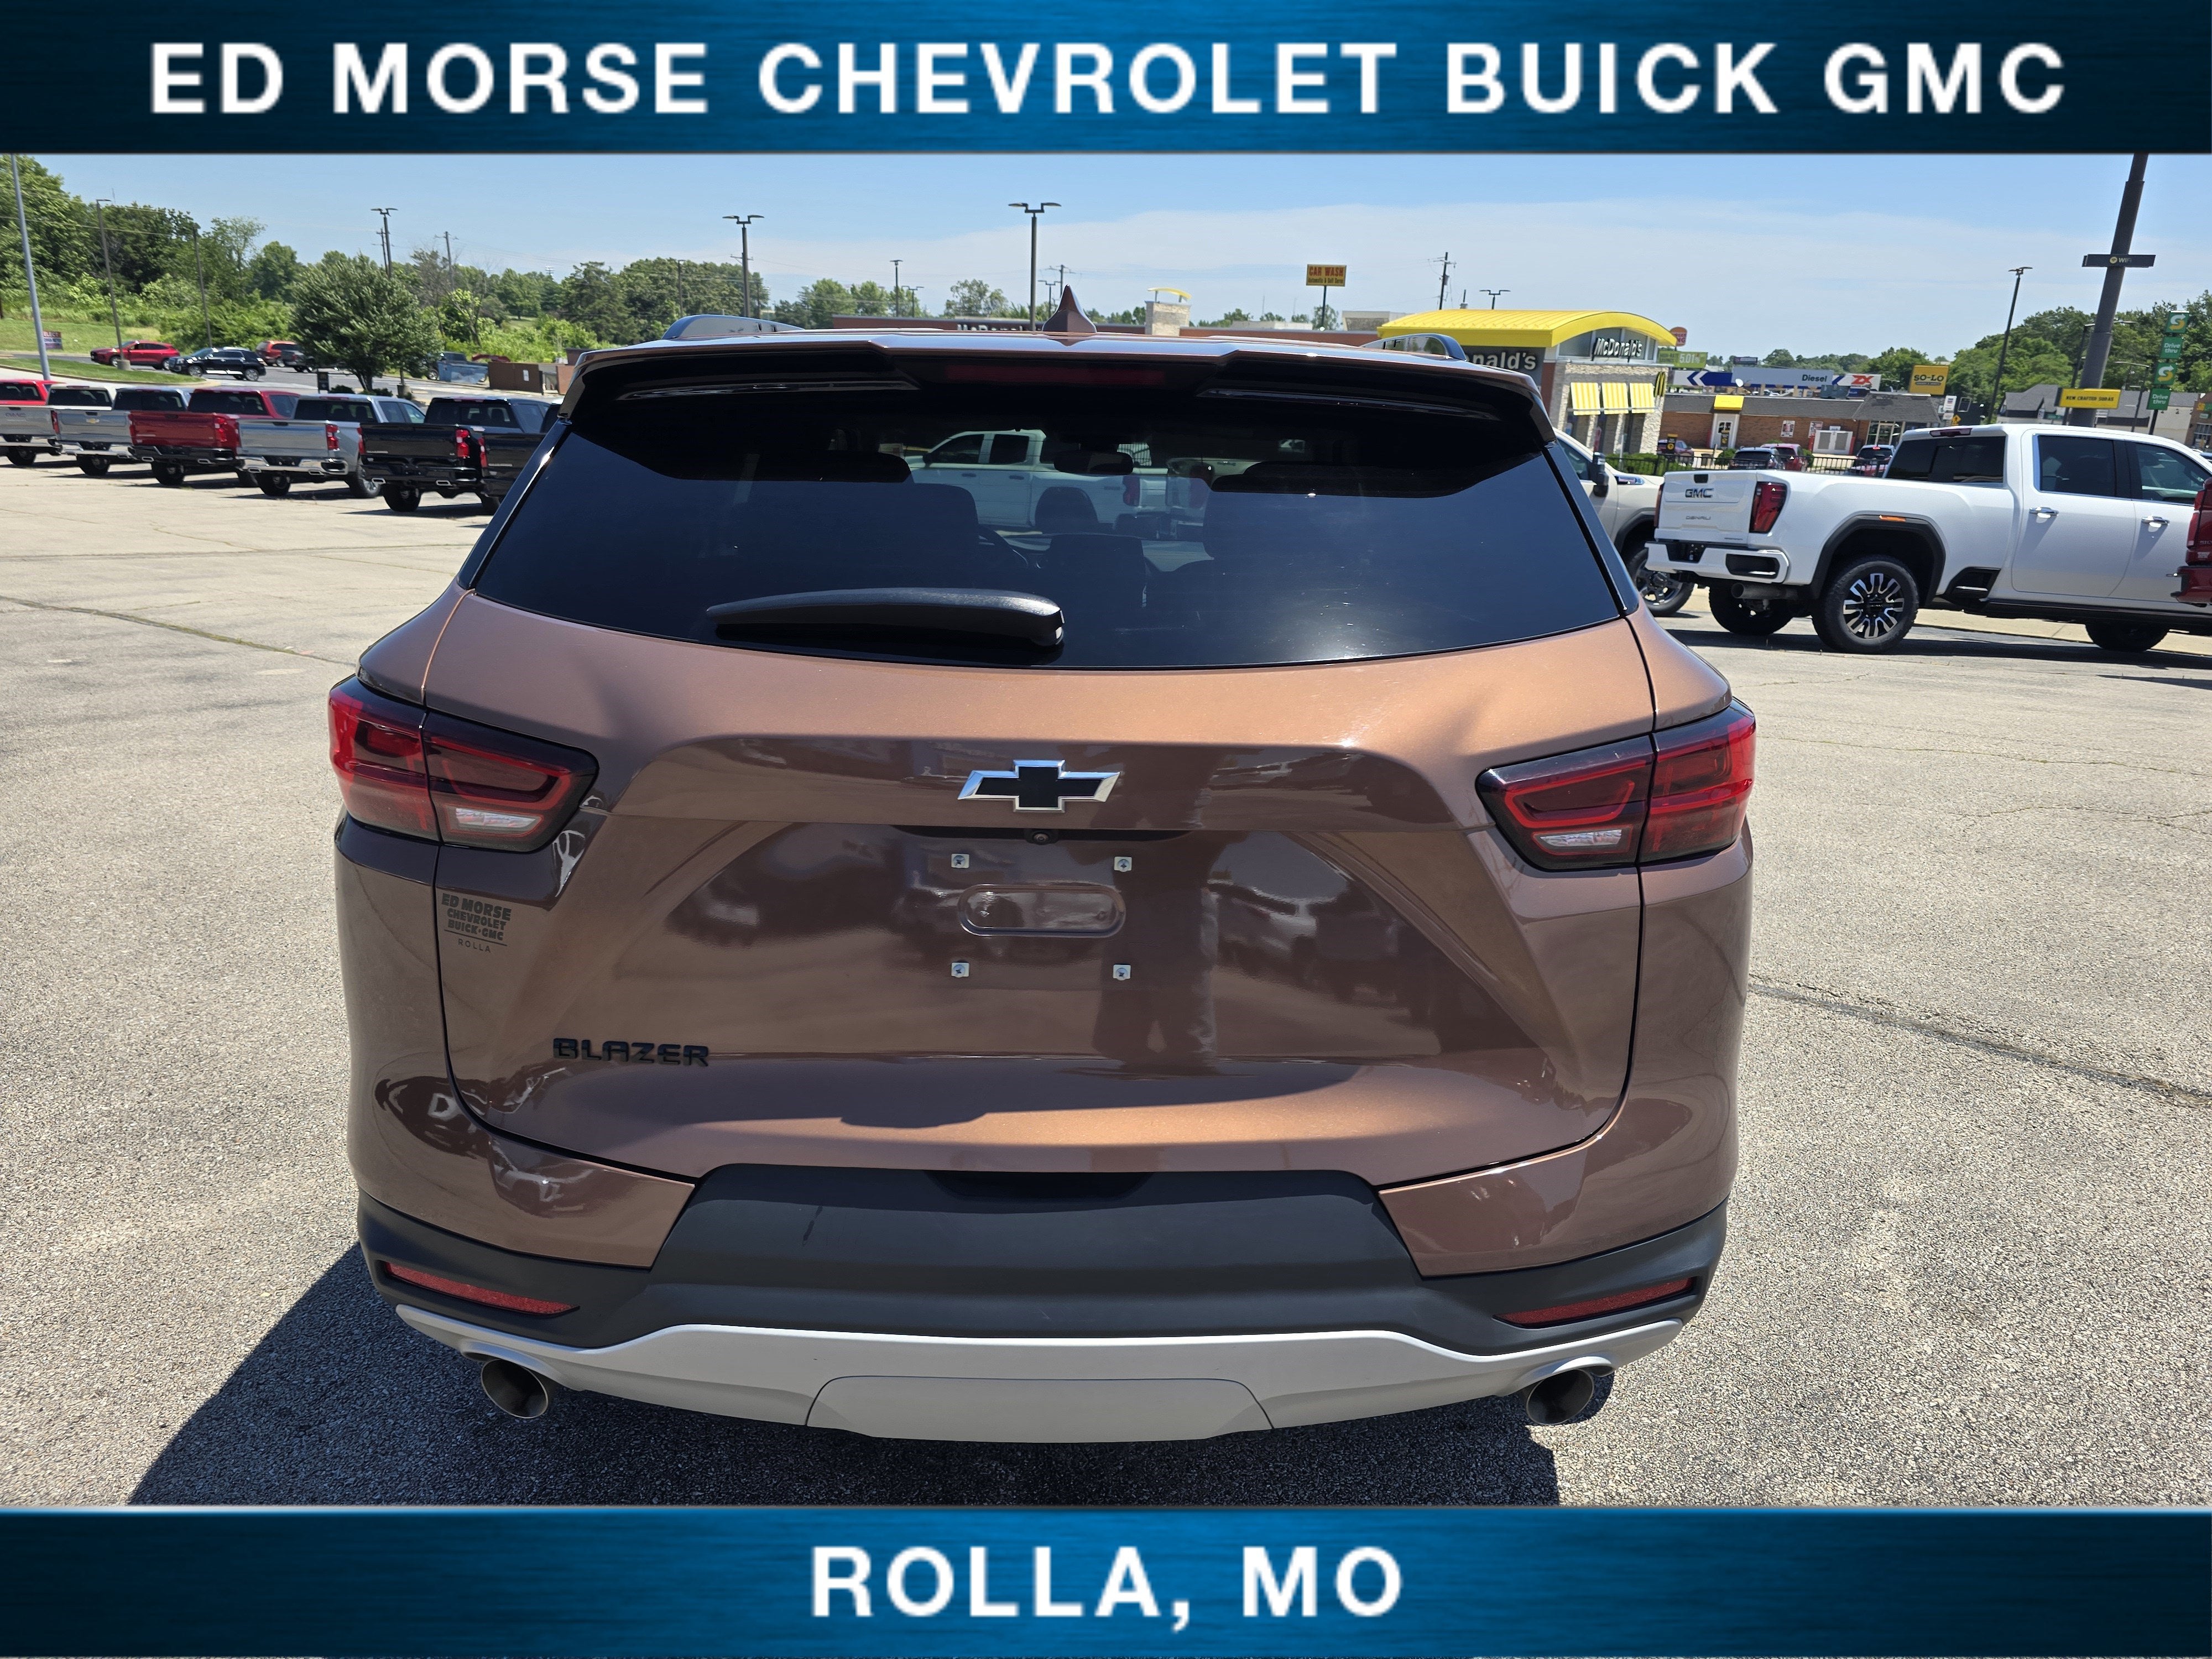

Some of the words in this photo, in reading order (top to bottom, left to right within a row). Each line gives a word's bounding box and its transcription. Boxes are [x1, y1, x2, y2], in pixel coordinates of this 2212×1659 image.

[1309, 266, 1322, 276] CAR
[1324, 267, 1344, 276] WASH
[1594, 338, 1642, 356] McDonald's
[1851, 375, 1874, 385] ZX
[1685, 488, 1714, 498] GMC
[441, 893, 460, 908] ED
[461, 898, 512, 921] MORSE
[447, 907, 507, 930] CHEVROLET
[458, 938, 491, 953] ROLLA
[553, 1037, 708, 1066] BLAZER
